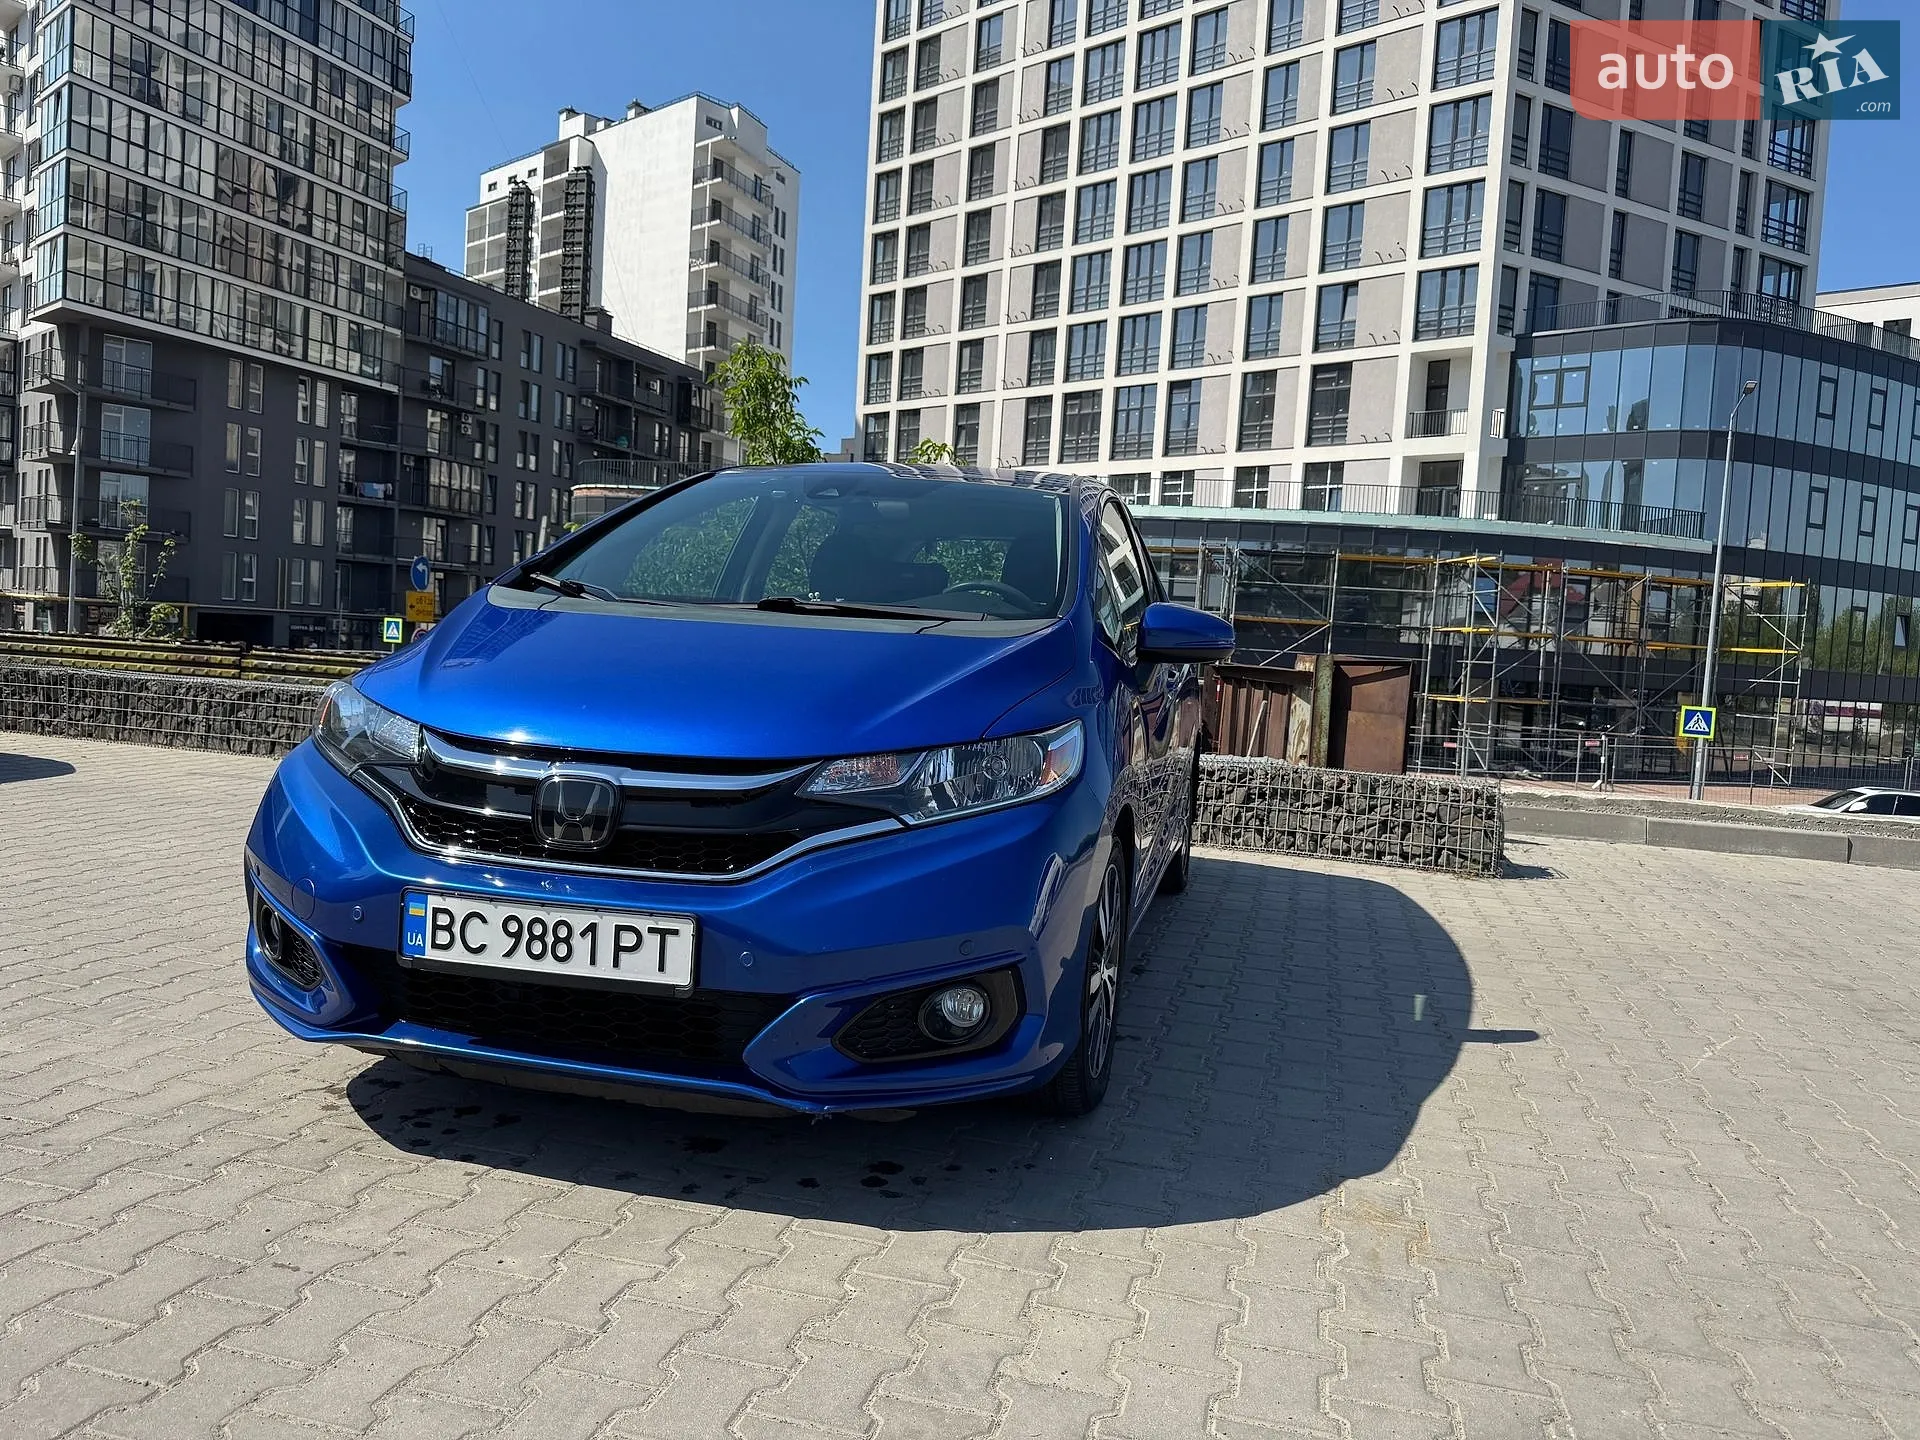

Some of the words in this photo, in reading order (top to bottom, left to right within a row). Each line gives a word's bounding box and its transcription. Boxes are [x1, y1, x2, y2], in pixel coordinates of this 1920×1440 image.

[407, 931, 424, 948] UA
[430, 907, 489, 954] BC
[500, 914, 598, 966] 9881
[610, 923, 680, 972] PT
